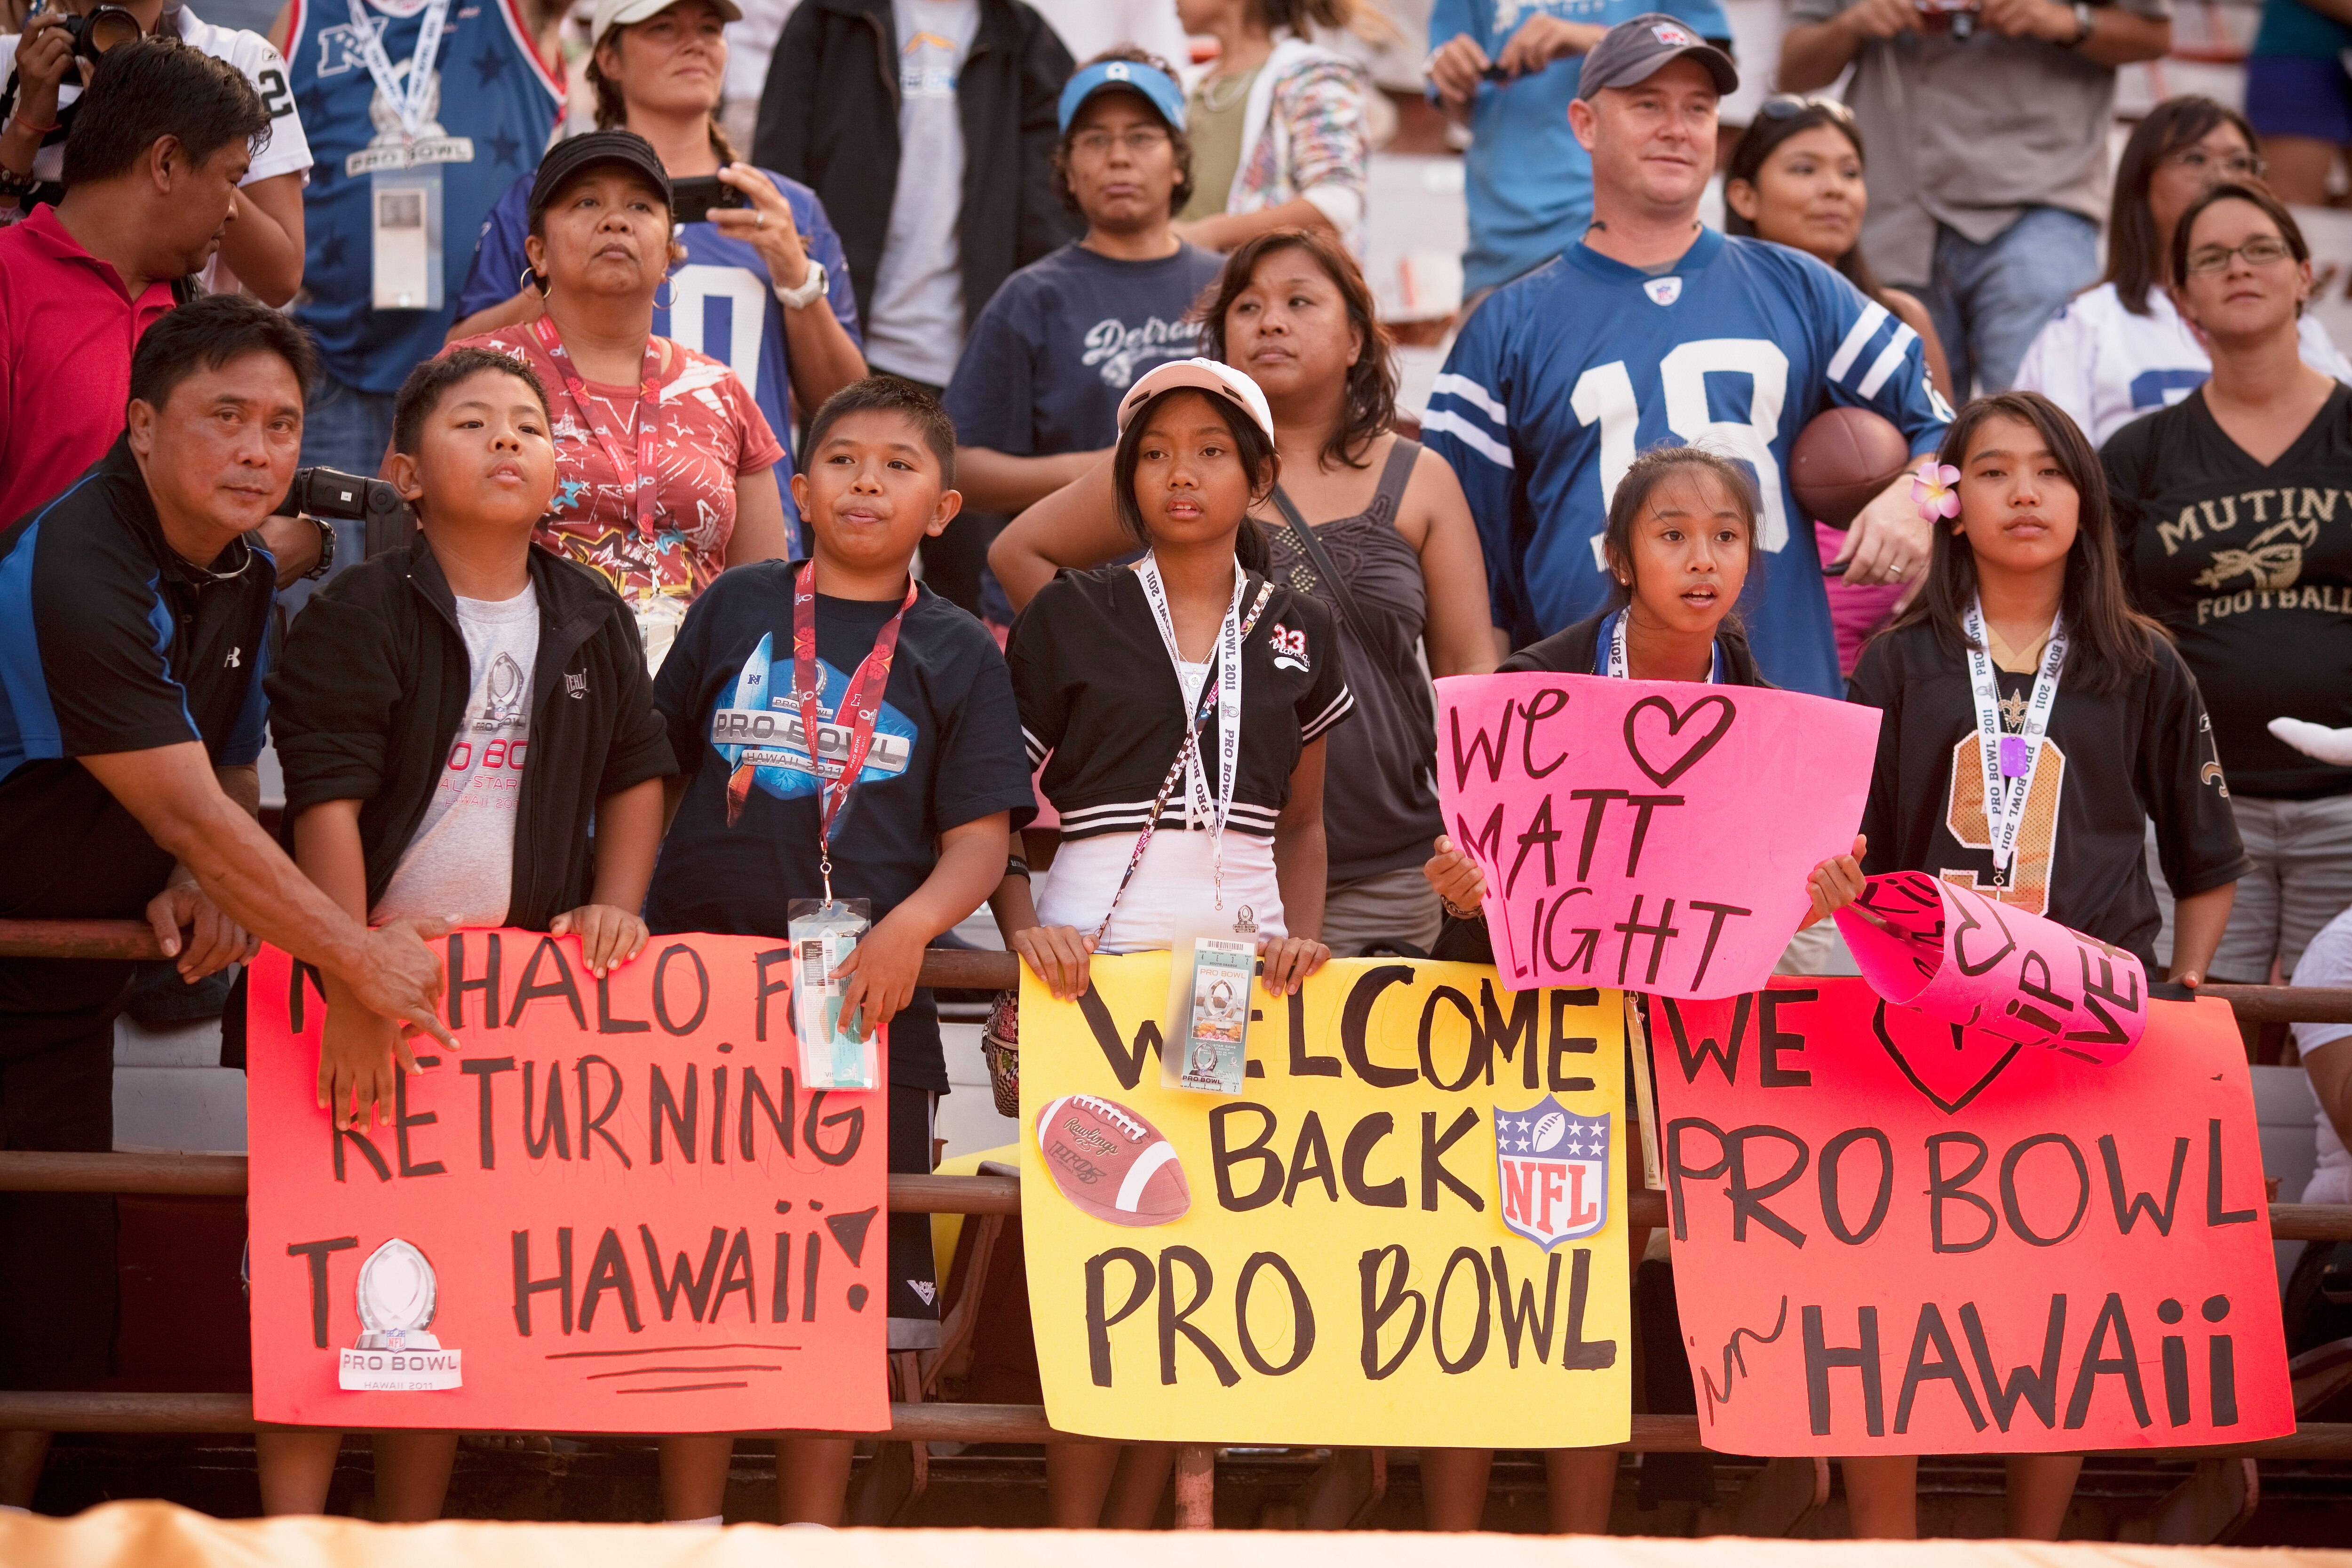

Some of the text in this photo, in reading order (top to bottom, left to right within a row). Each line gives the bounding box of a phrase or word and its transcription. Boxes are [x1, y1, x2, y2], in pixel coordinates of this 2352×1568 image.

[1570, 338, 1789, 573] 18
[2156, 486, 2352, 557] MUTIN
[1146, 570, 1160, 597] 2011
[1225, 618, 1236, 659] BOWL
[1273, 623, 1305, 655] 33
[1611, 636, 1621, 665] 2011
[1225, 664, 1236, 690] 2011
[1974, 651, 1986, 676] PRO
[2043, 645, 2063, 679] BOWL
[775, 699, 797, 709] PRO
[2035, 685, 2050, 709] 2011
[716, 714, 775, 739] PRO
[1983, 709, 1994, 734] 2011
[1224, 729, 1234, 758] PRO
[747, 752, 842, 777] HAWAII 2011
[853, 756, 862, 772] HAWAII
[1986, 740, 1999, 781] BOWL
[1222, 762, 1232, 804] BOWL
[2009, 776, 2027, 818] BOWL
[1195, 784, 1210, 814] PRO
[1990, 787, 2002, 815] PRO
[1457, 789, 1685, 900] MATT
[2001, 824, 2015, 850] 2011
[1502, 887, 1752, 992] LIGHT
[289, 933, 709, 1036] HALO
[1221, 971, 1246, 979] BOWL
[1077, 963, 1600, 1092] WLCOME
[1662, 989, 1819, 1087] WE
[1064, 1117, 1118, 1156] Rawlings
[1209, 1102, 1485, 1212] BACK
[1502, 1159, 1599, 1237] NFL
[1666, 1117, 2257, 1253] PRO BOWL
[919, 1281, 934, 1294] PONY
[1084, 1244, 1617, 1388] PRO BOWL
[388, 1337, 405, 1348] NFL
[343, 1354, 457, 1371] PRO BOWL
[364, 1381, 403, 1390] HAWAII
